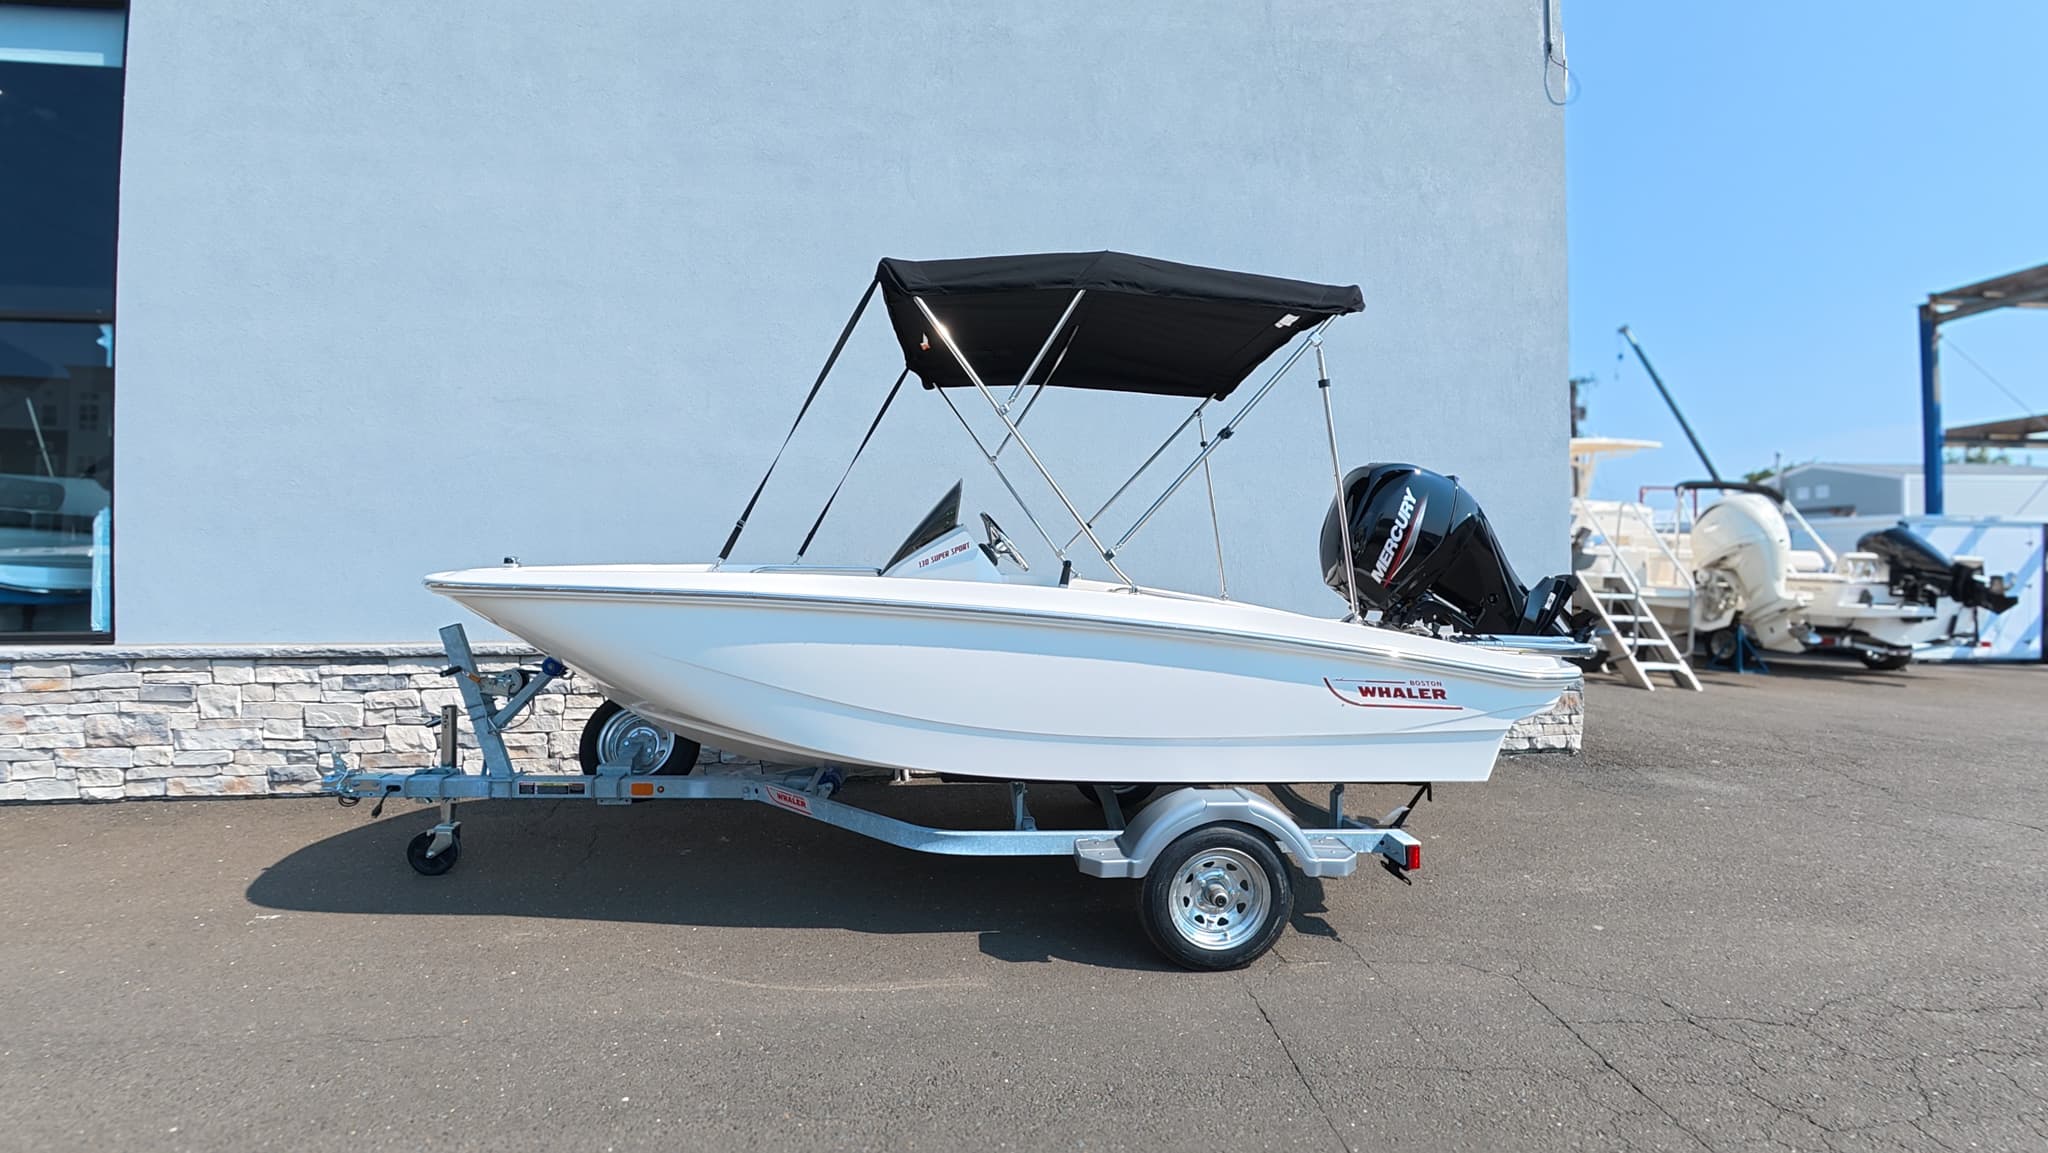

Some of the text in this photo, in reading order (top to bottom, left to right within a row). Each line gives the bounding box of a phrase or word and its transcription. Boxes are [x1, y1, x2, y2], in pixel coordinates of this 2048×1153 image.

[1371, 487, 1416, 584] MERCURY
[931, 550, 949, 563] SUPER
[951, 541, 970, 555] SPORT
[1358, 686, 1447, 700] WHALER
